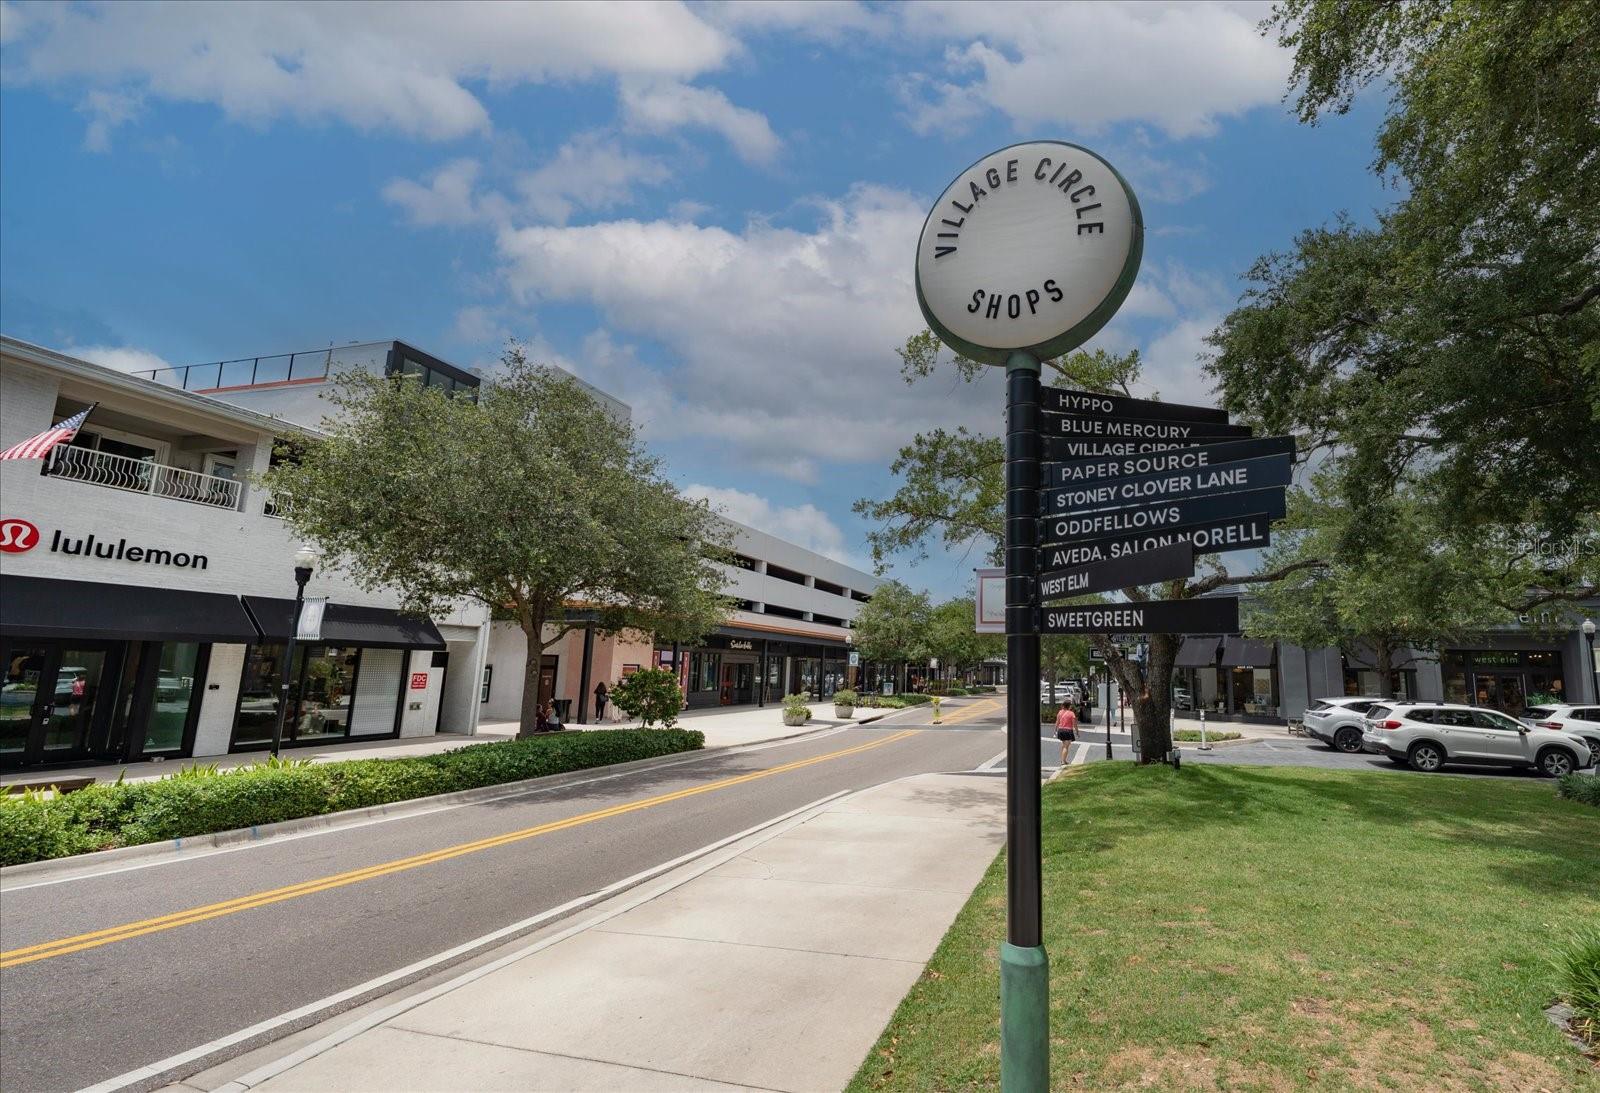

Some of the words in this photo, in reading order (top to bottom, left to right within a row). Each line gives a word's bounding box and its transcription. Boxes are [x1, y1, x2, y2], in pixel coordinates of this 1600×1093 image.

[935, 159, 1019, 259] VILLAGE
[1034, 157, 1104, 236] CIRCLE
[967, 279, 1064, 319] SHOPS
[1059, 394, 1113, 413] HYPPO
[1061, 419, 1103, 434] BLUE
[1106, 422, 1190, 439] MERCURY
[1067, 443, 1136, 456] VILLAGE
[1061, 462, 1120, 481] PAPER
[1124, 451, 1209, 474] SOURCE
[1057, 486, 1118, 508] STONEY
[1121, 475, 1192, 499] CLOVER
[1197, 468, 1248, 489] LANE
[1055, 507, 1181, 536] ODDFELLOWS
[50, 529, 209, 570] lululemon
[1052, 546, 1107, 567] AVEDA,
[1041, 576, 1067, 596] WEST
[1068, 572, 1090, 591] ELM
[1048, 609, 1145, 628] SWEETGREEN
[1500, 655, 1519, 664] elm
